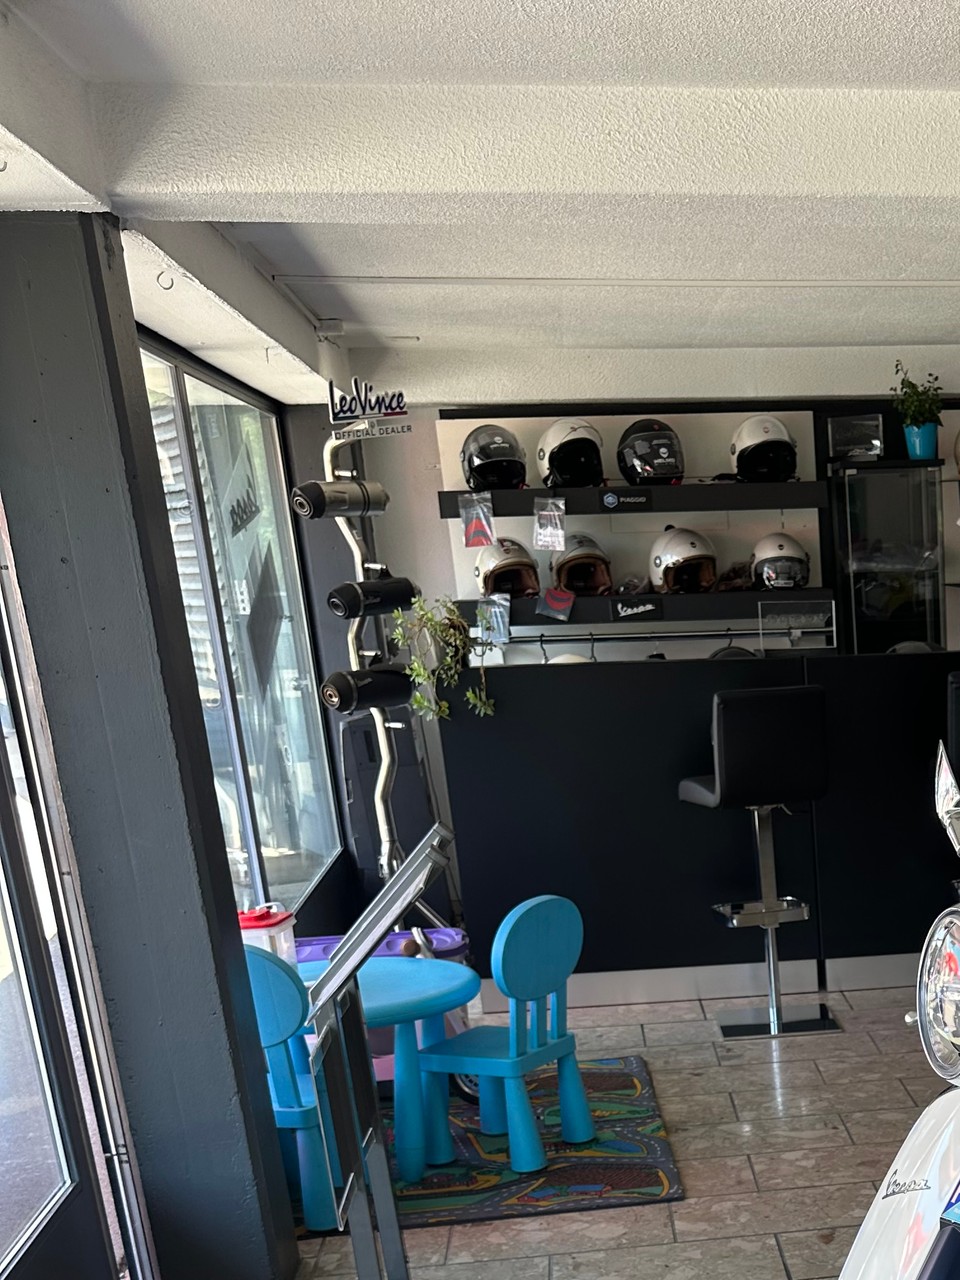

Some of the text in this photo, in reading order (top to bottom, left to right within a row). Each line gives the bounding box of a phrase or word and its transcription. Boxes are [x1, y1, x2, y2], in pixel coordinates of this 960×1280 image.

[328, 376, 407, 417] LeoVince
[334, 424, 412, 440] OFFICIAL DEALER
[617, 602, 656, 617] Vespa
[882, 1169, 931, 1200] Vespa
